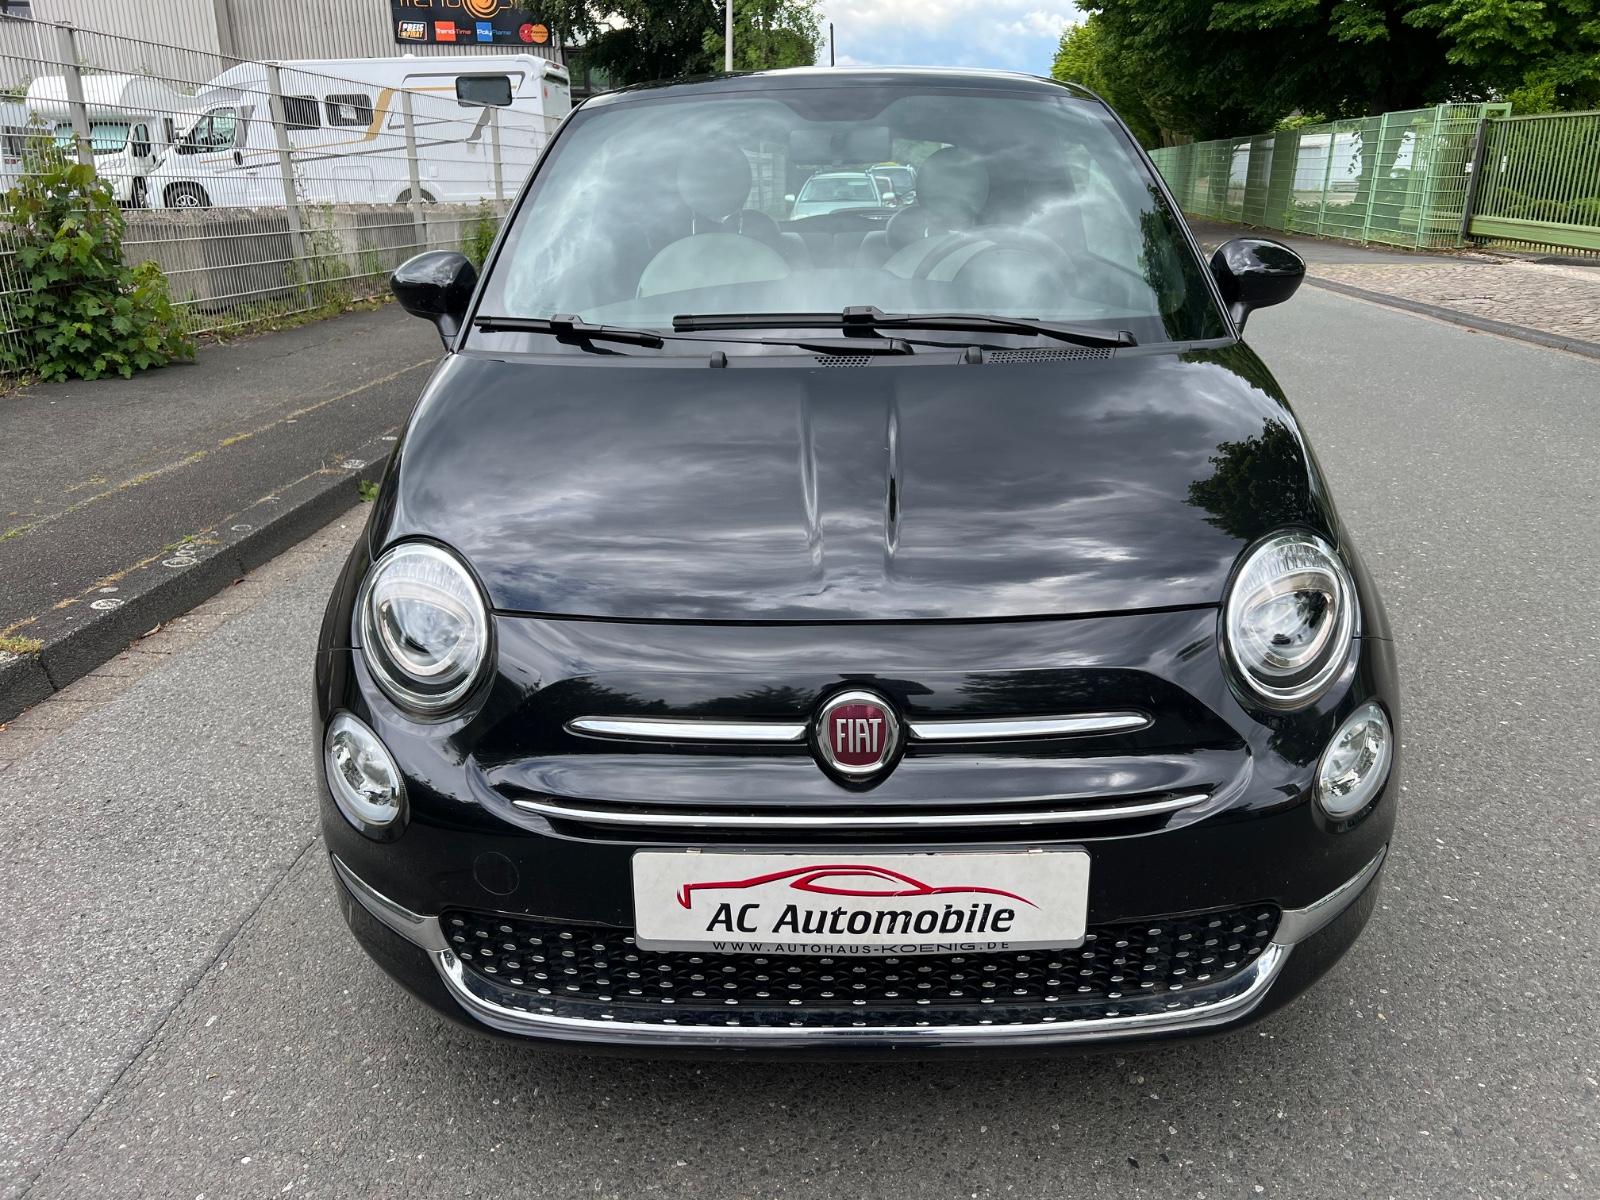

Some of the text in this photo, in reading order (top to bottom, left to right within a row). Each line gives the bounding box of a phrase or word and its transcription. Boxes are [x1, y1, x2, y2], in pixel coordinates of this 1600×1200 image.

[402, 23, 424, 32] PREIS
[836, 718, 882, 753] FIAT
[706, 902, 1015, 934] AC Automobile
[713, 942, 1009, 954] WWW.AUTOHAUS-KOENIG.DE
